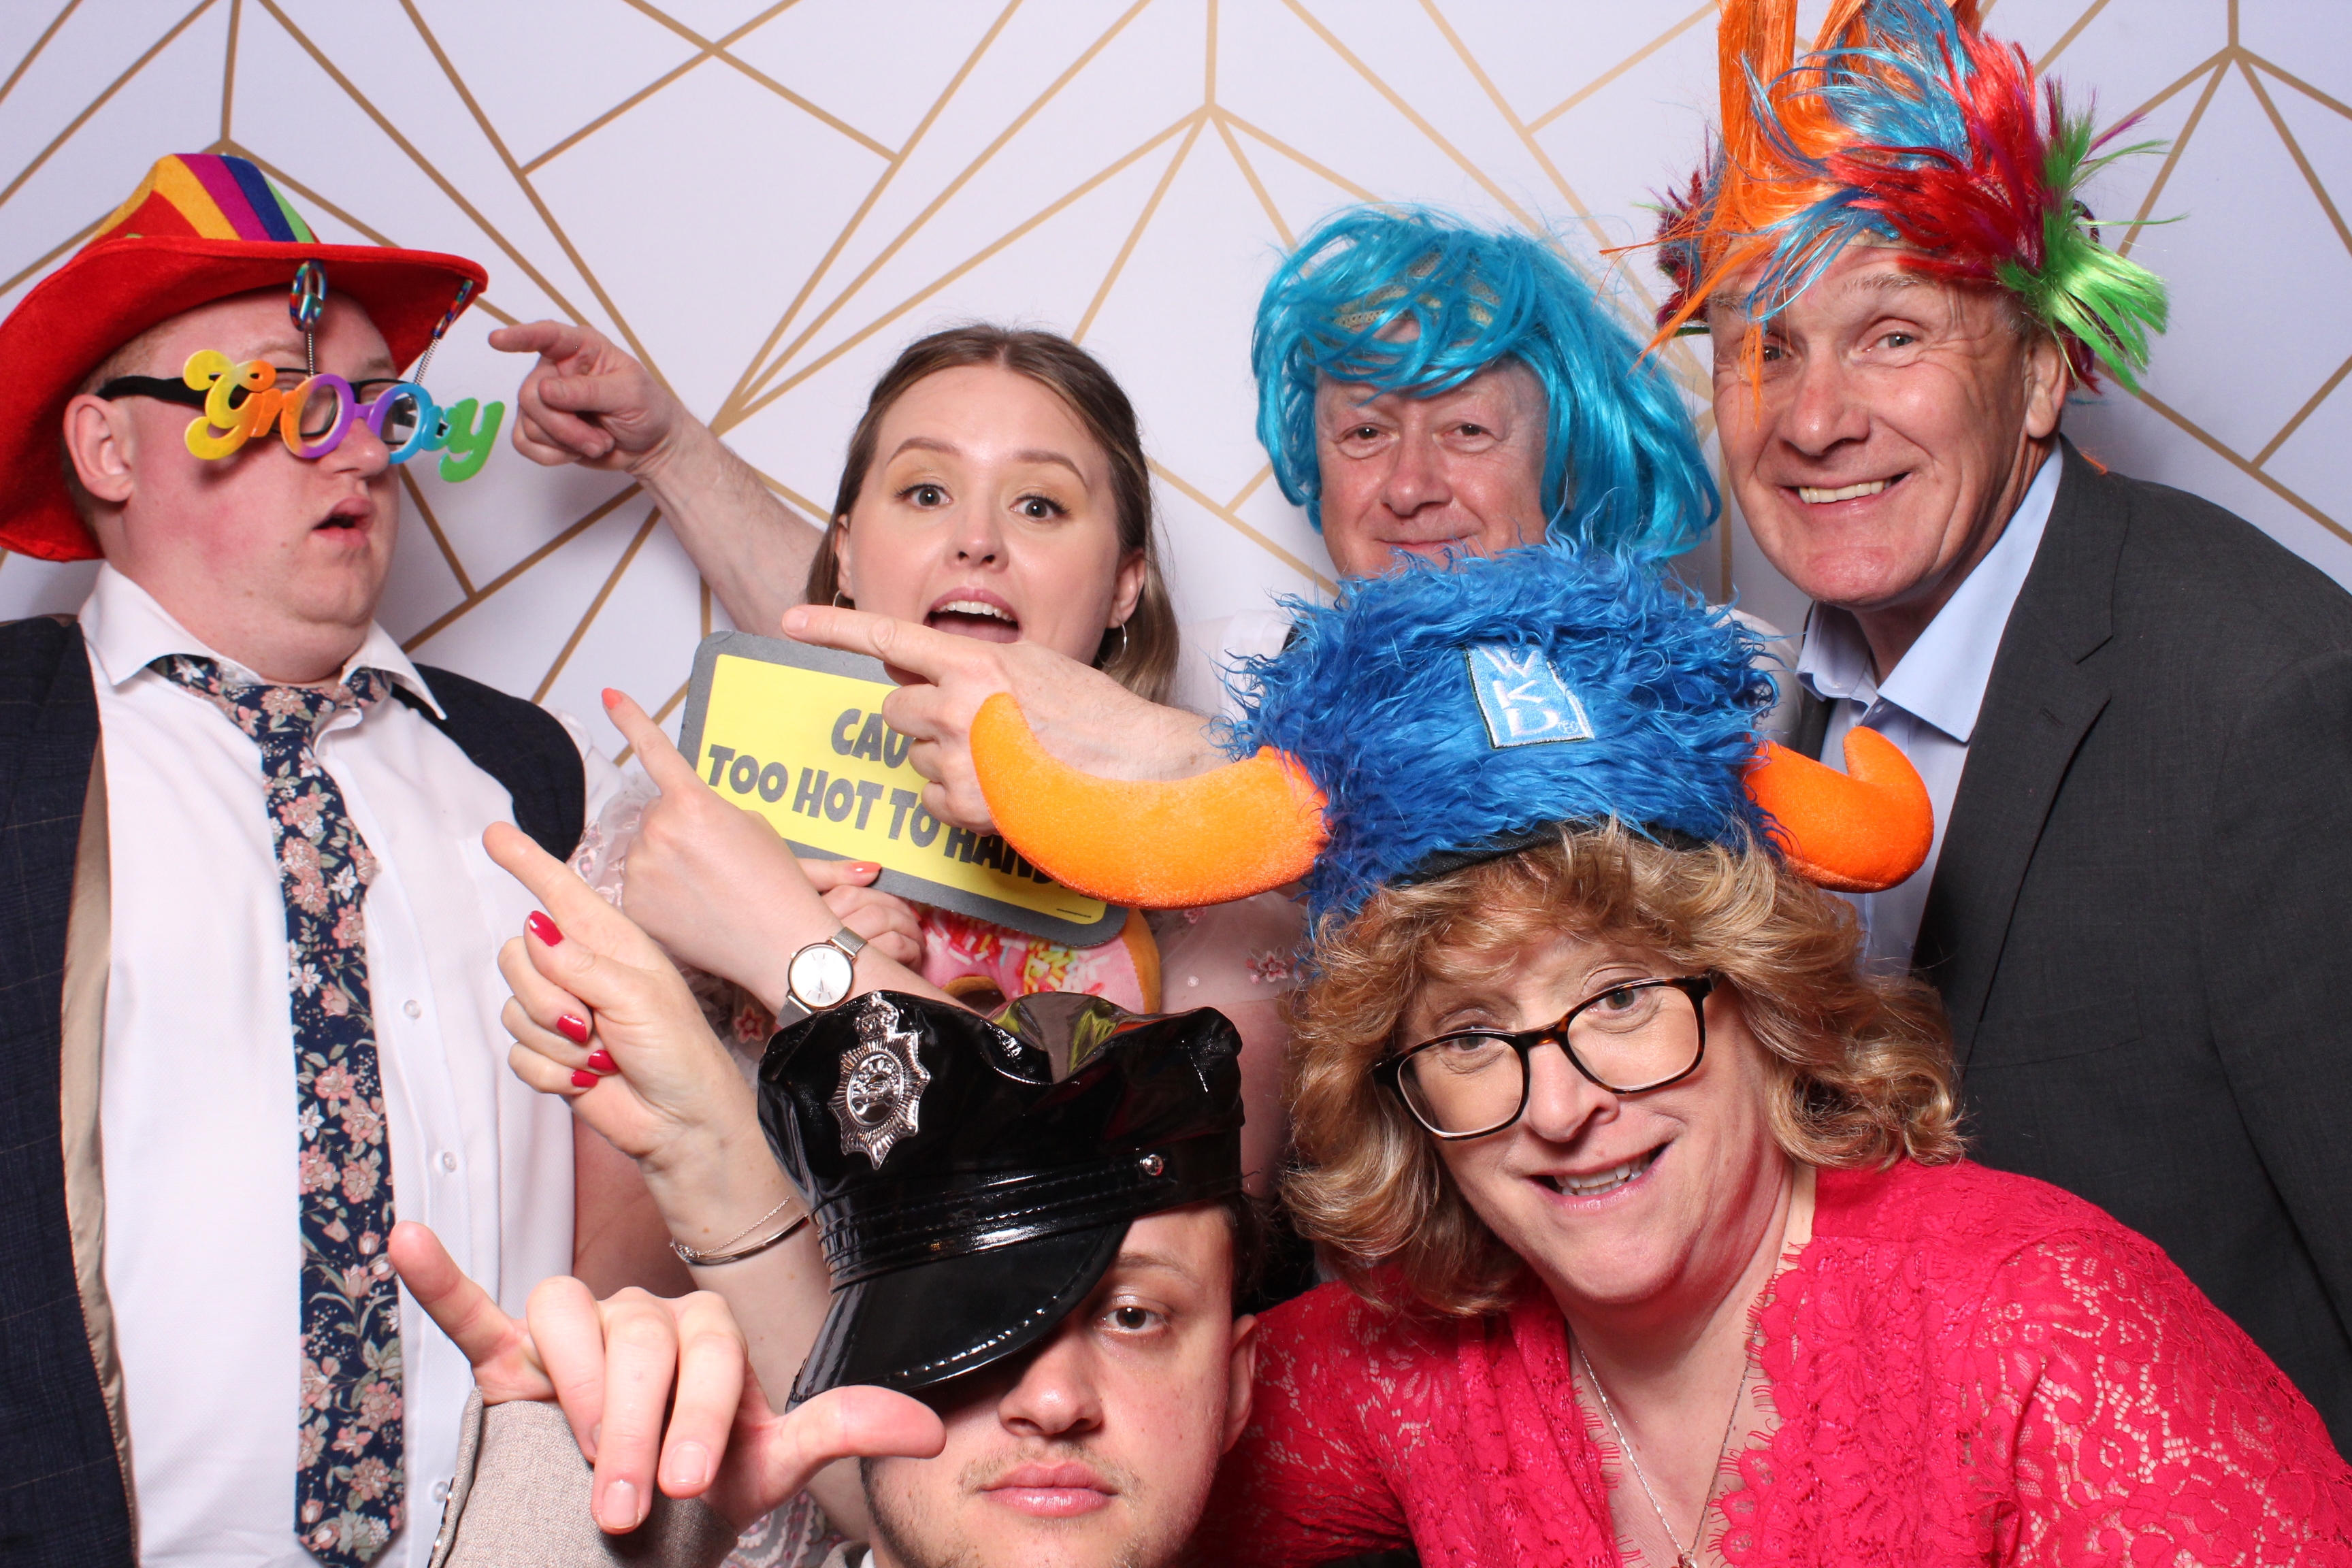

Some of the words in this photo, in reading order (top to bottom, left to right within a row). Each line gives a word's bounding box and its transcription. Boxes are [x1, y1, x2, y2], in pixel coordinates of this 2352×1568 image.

[708, 744, 788, 803] TOO
[792, 766, 884, 830] HOT
[888, 788, 941, 847] TO
